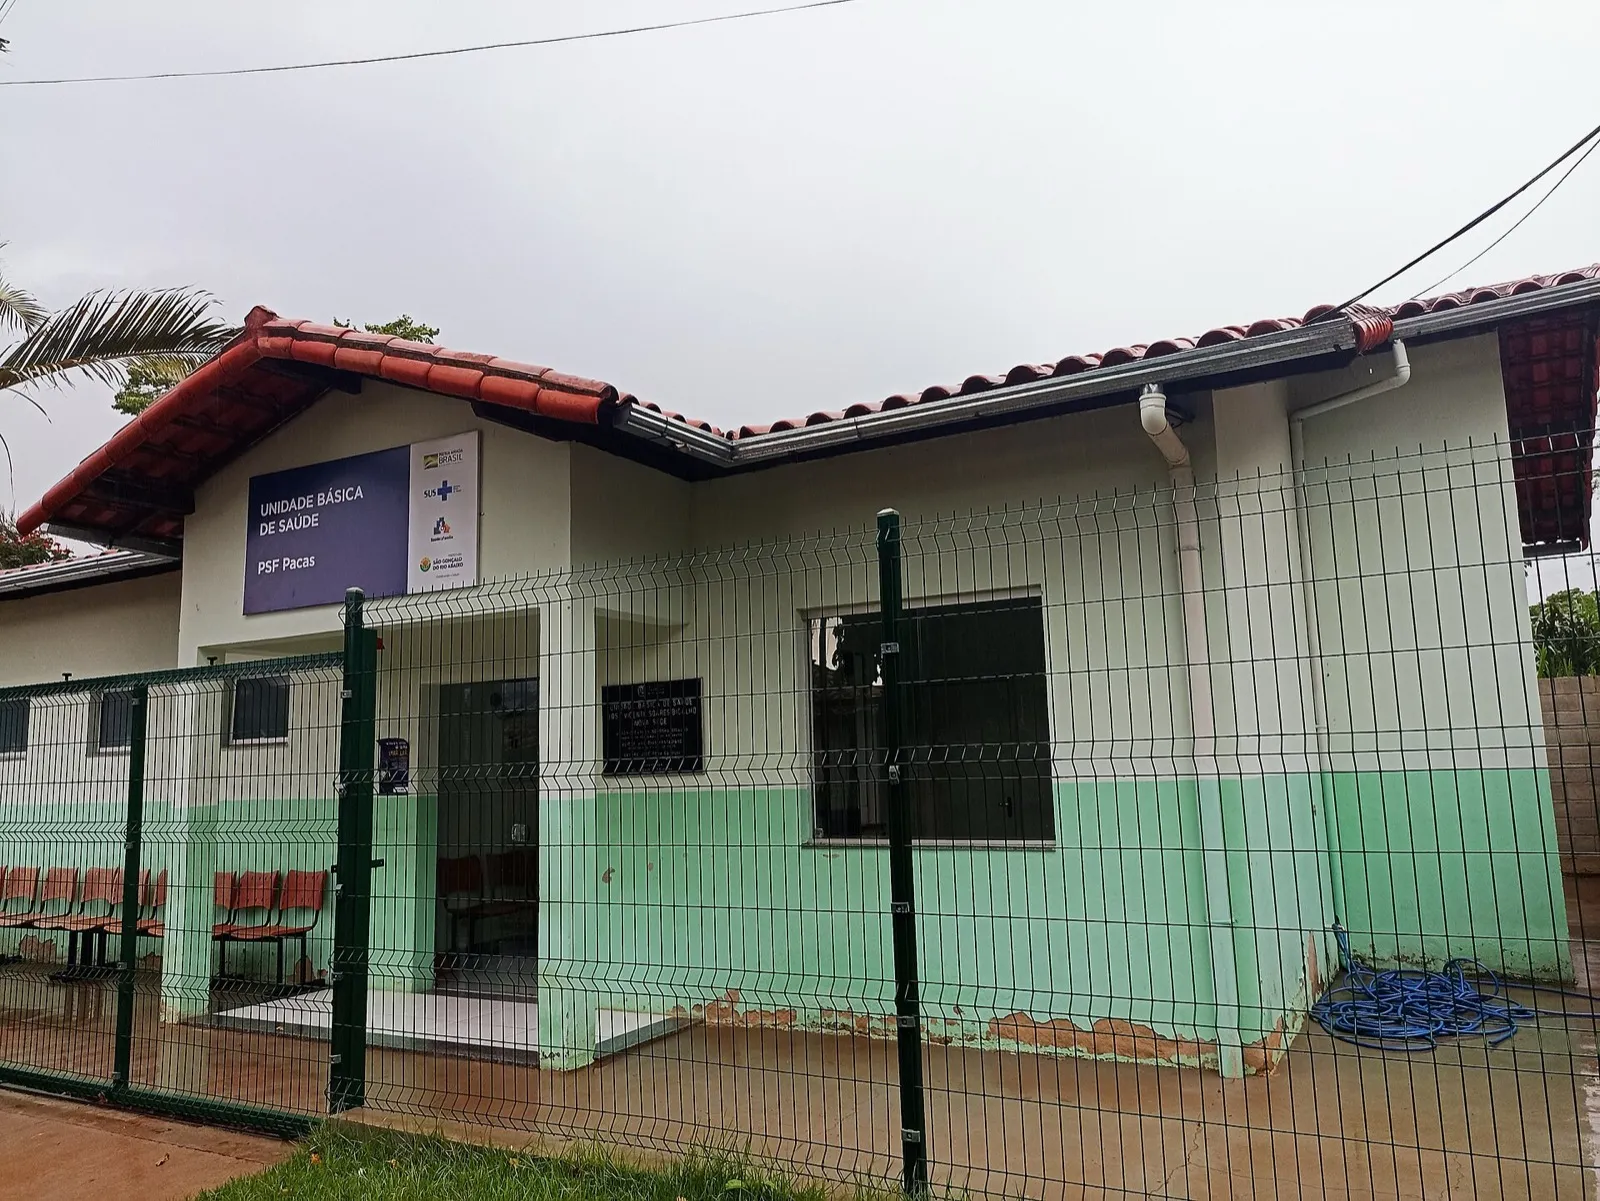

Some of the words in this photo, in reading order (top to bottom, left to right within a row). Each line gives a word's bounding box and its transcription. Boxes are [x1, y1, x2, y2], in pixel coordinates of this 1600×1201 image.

[439, 454, 463, 464] BRASIL
[260, 494, 314, 517] UNIDADE
[317, 485, 364, 505] BÁSICA
[424, 488, 436, 498] SUS
[260, 521, 275, 536] DE
[278, 513, 319, 533] SAÚDE
[258, 559, 279, 575] PSF
[282, 555, 316, 571] Pacas
